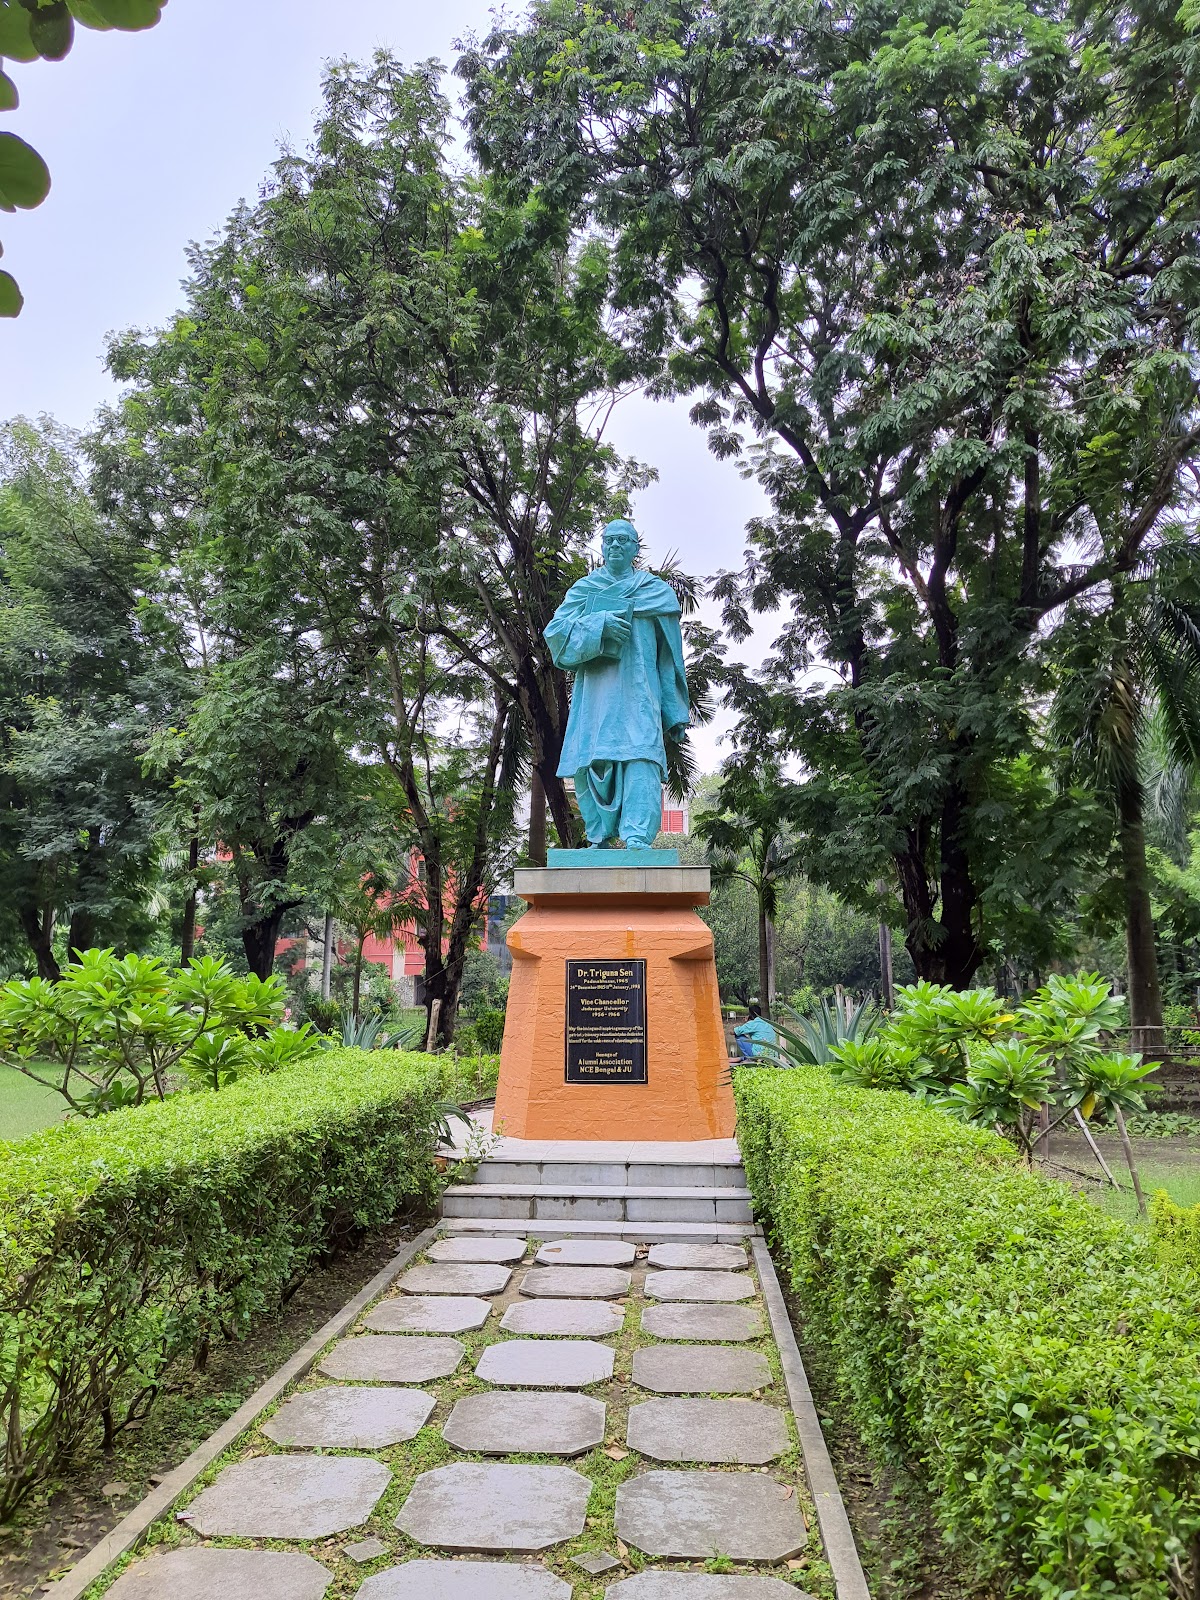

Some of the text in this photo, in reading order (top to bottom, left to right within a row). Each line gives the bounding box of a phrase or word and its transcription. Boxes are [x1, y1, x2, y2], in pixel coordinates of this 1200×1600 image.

[577, 968, 633, 979] Dr. Triguna Sen
[594, 1066, 617, 1075] Bengal
